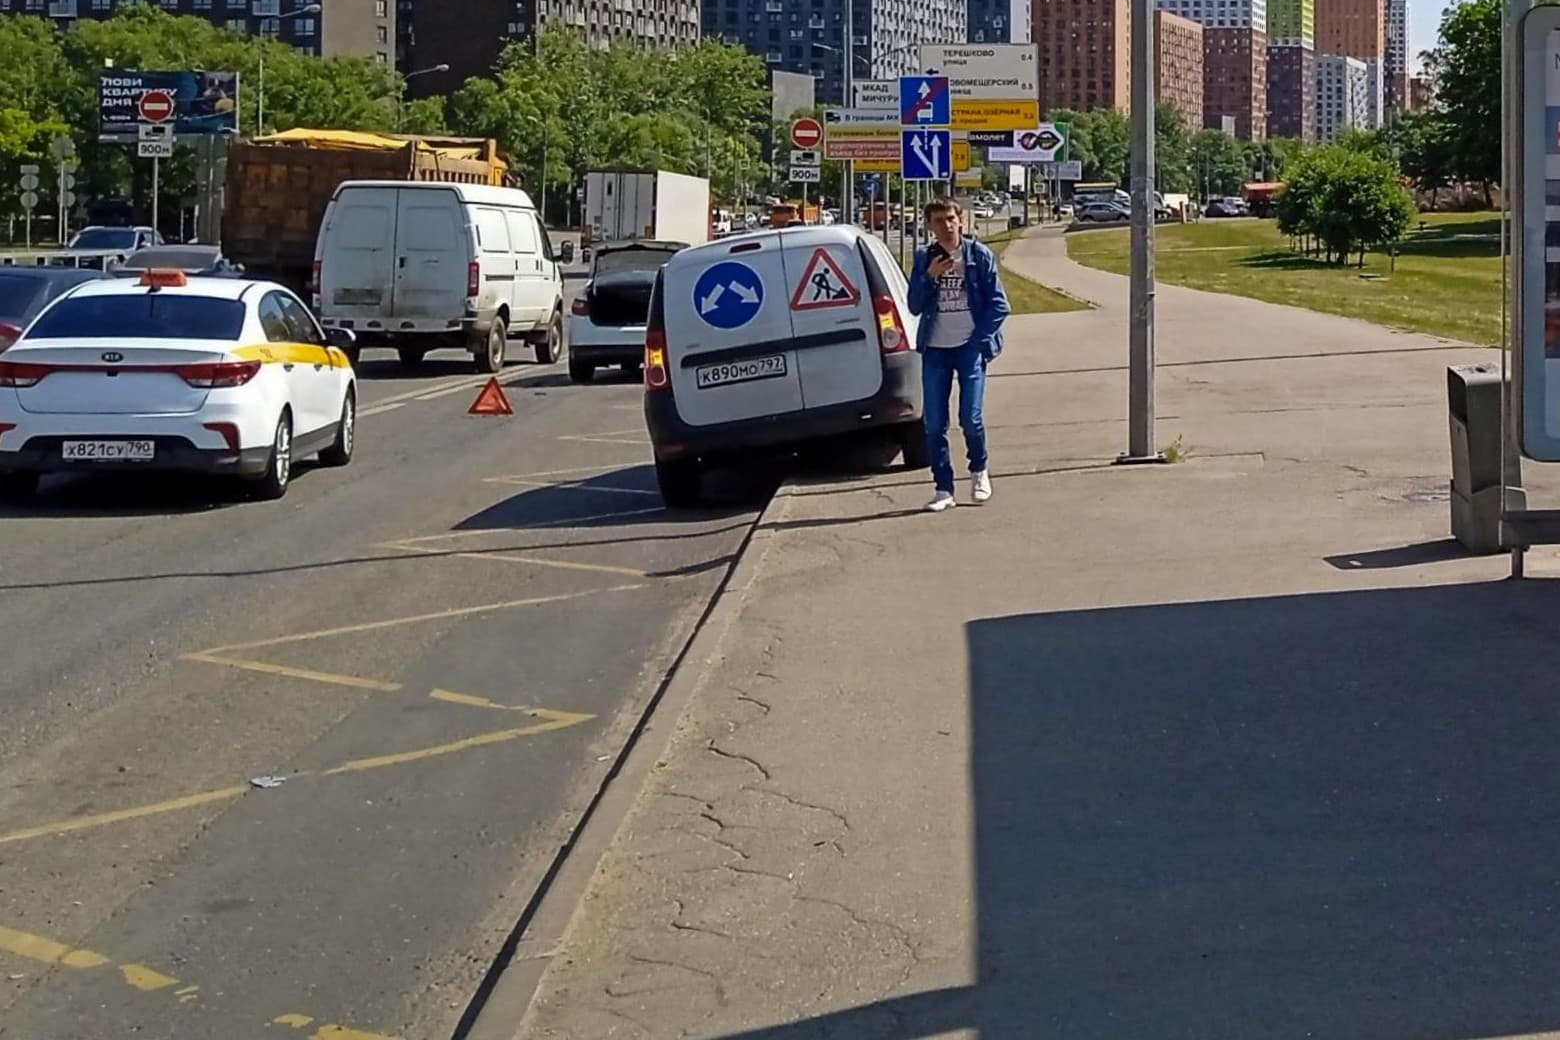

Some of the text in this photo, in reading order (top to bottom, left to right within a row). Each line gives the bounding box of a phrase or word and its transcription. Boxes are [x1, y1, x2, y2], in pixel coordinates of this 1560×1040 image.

[102, 78, 142, 87] ЛОВИ
[862, 84, 888, 93] МКАД
[102, 98, 132, 107] ДНЯ
